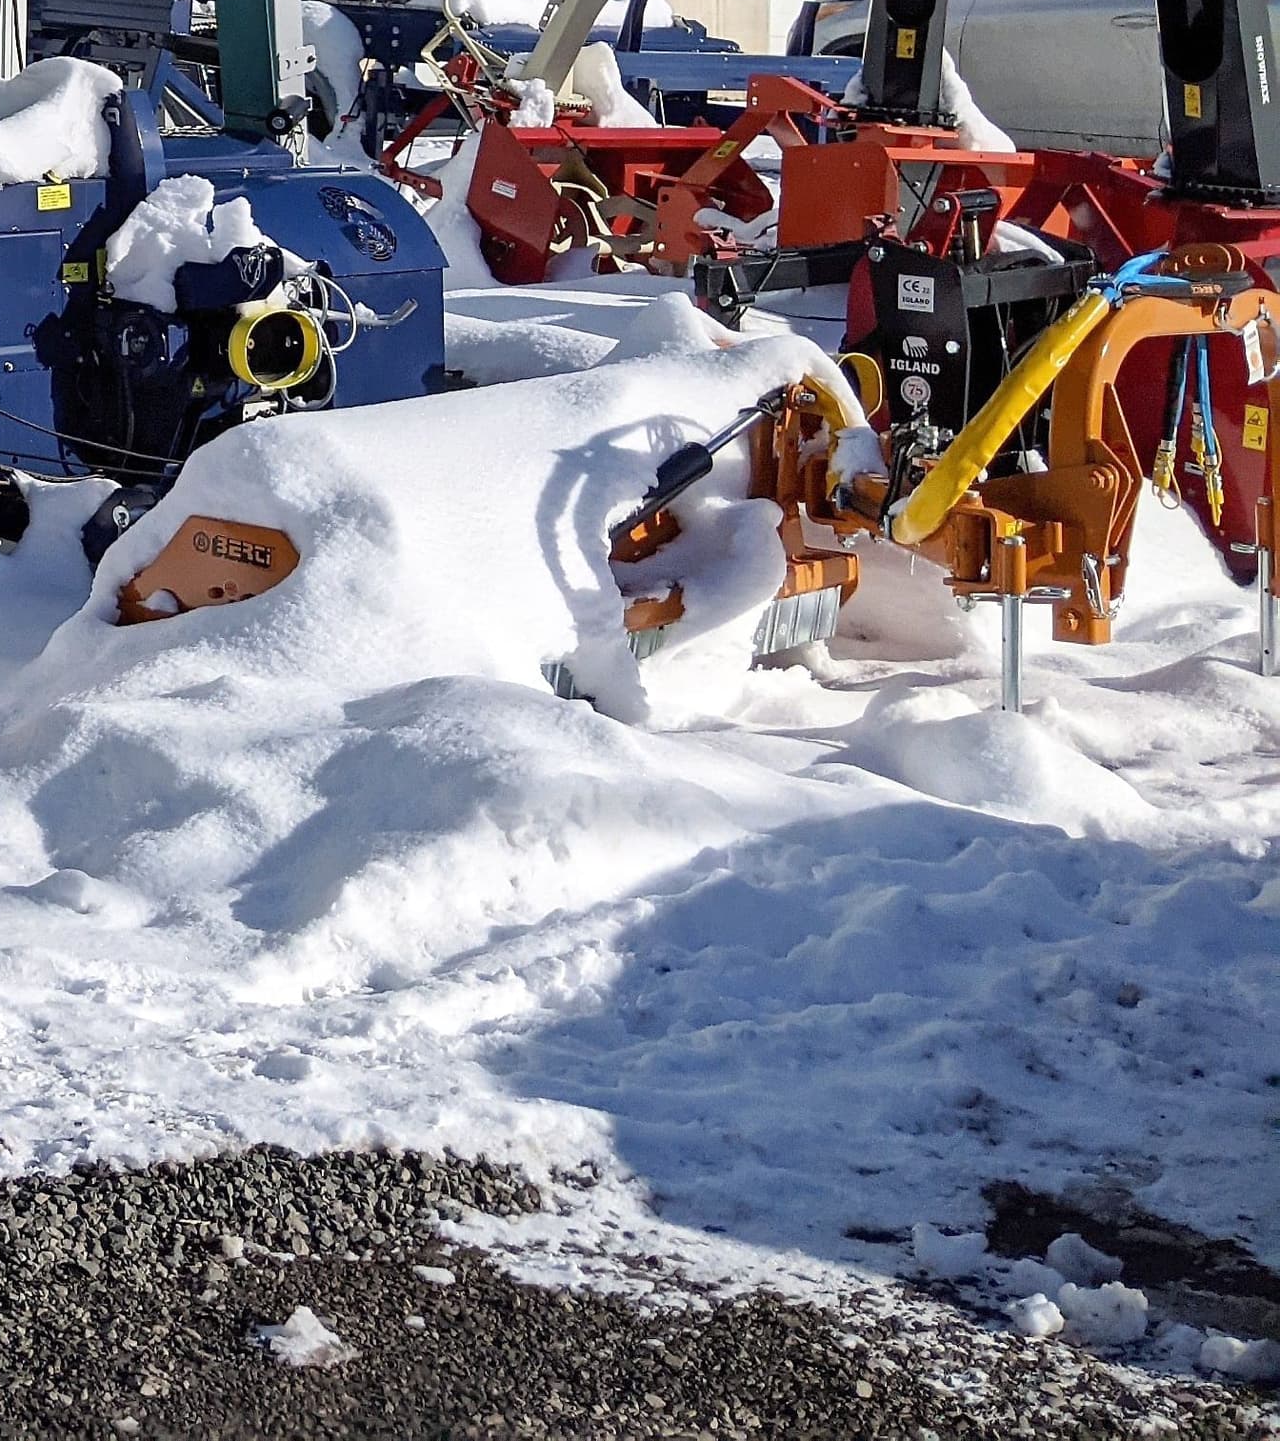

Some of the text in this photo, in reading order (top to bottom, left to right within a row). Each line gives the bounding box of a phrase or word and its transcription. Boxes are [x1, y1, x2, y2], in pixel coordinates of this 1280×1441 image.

[903, 280, 920, 293] CE
[902, 296, 930, 305] IGLAND
[890, 358, 940, 375] IGLAND
